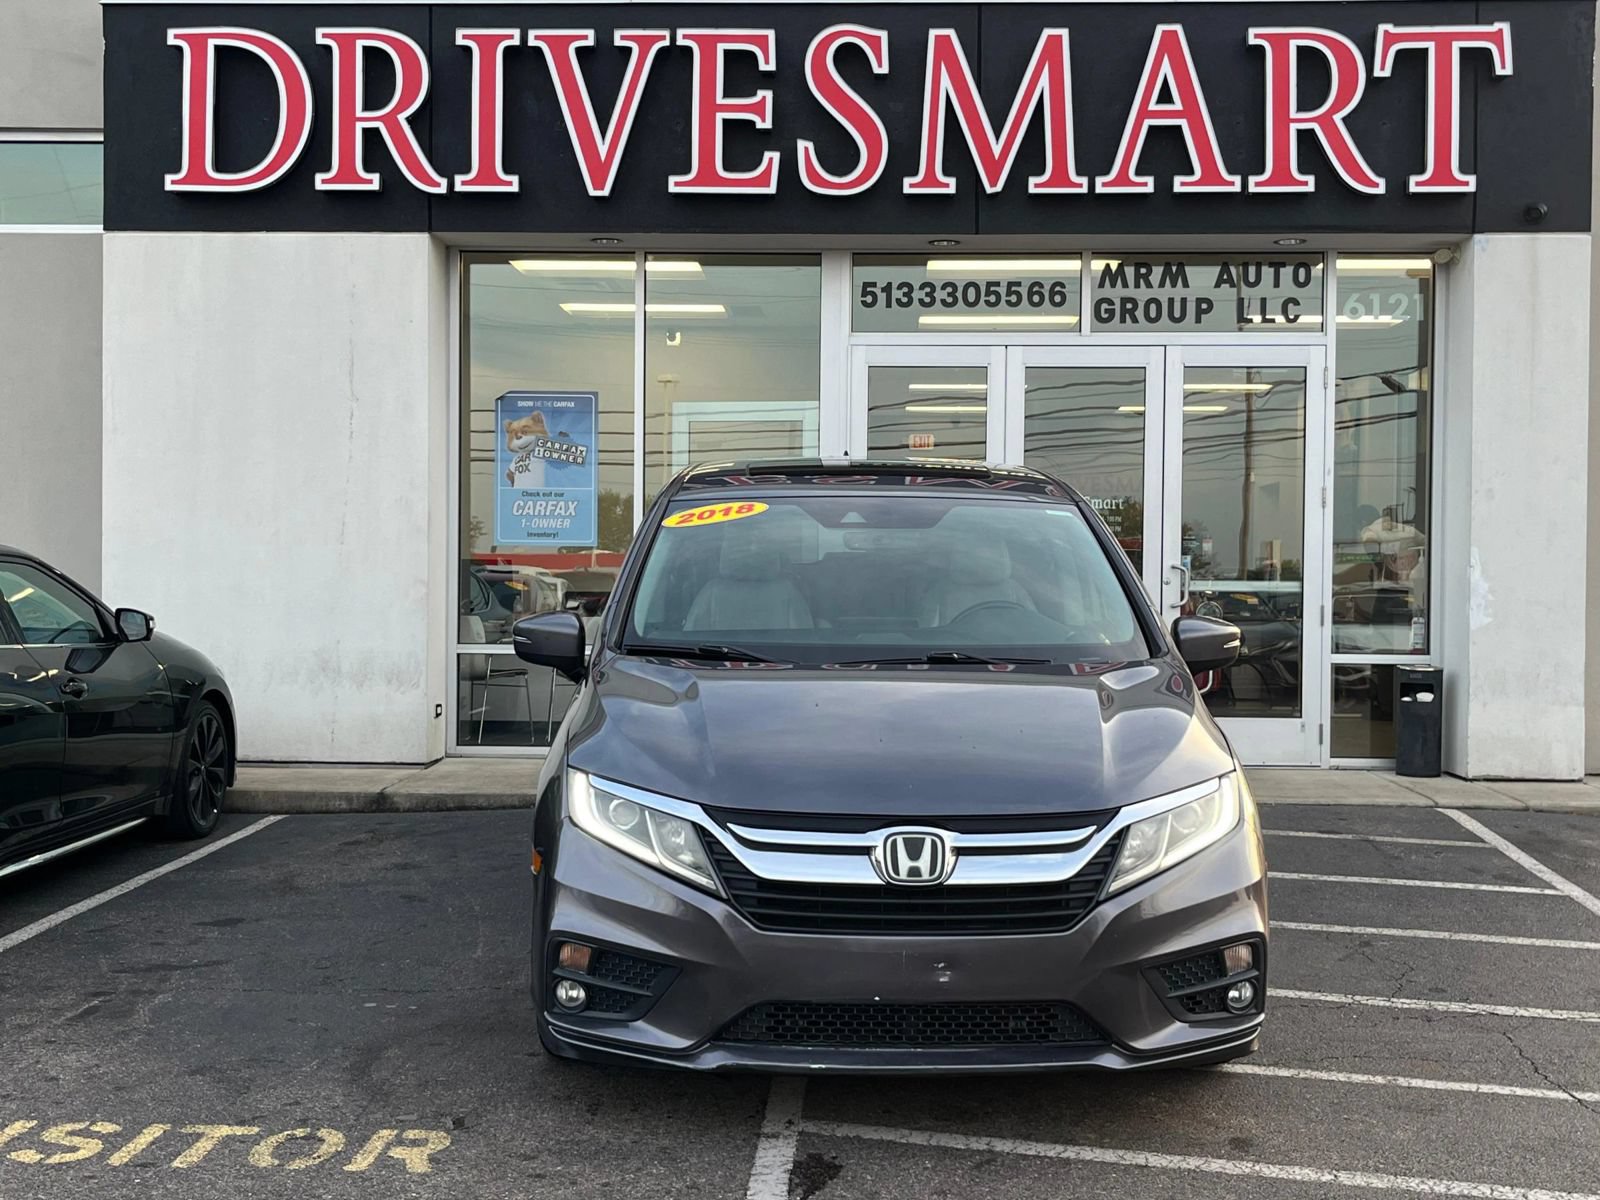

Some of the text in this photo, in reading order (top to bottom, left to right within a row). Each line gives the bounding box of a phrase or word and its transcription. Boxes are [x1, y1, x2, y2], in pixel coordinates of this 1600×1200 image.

[164, 21, 1513, 197] DRIVESMART
[1098, 260, 1312, 290] MRM AUTO
[859, 280, 1068, 310] 5133305566
[1093, 296, 1302, 325] GROUP LLC
[1342, 292, 1425, 322] 6121
[517, 400, 534, 408] SHOW
[537, 438, 586, 457] CARFAX
[514, 453, 532, 465] CAR
[514, 463, 531, 474] FOX
[521, 490, 541, 498] Check
[542, 490, 553, 498] out
[512, 500, 577, 516] CARFAX
[675, 503, 755, 525] 2018
